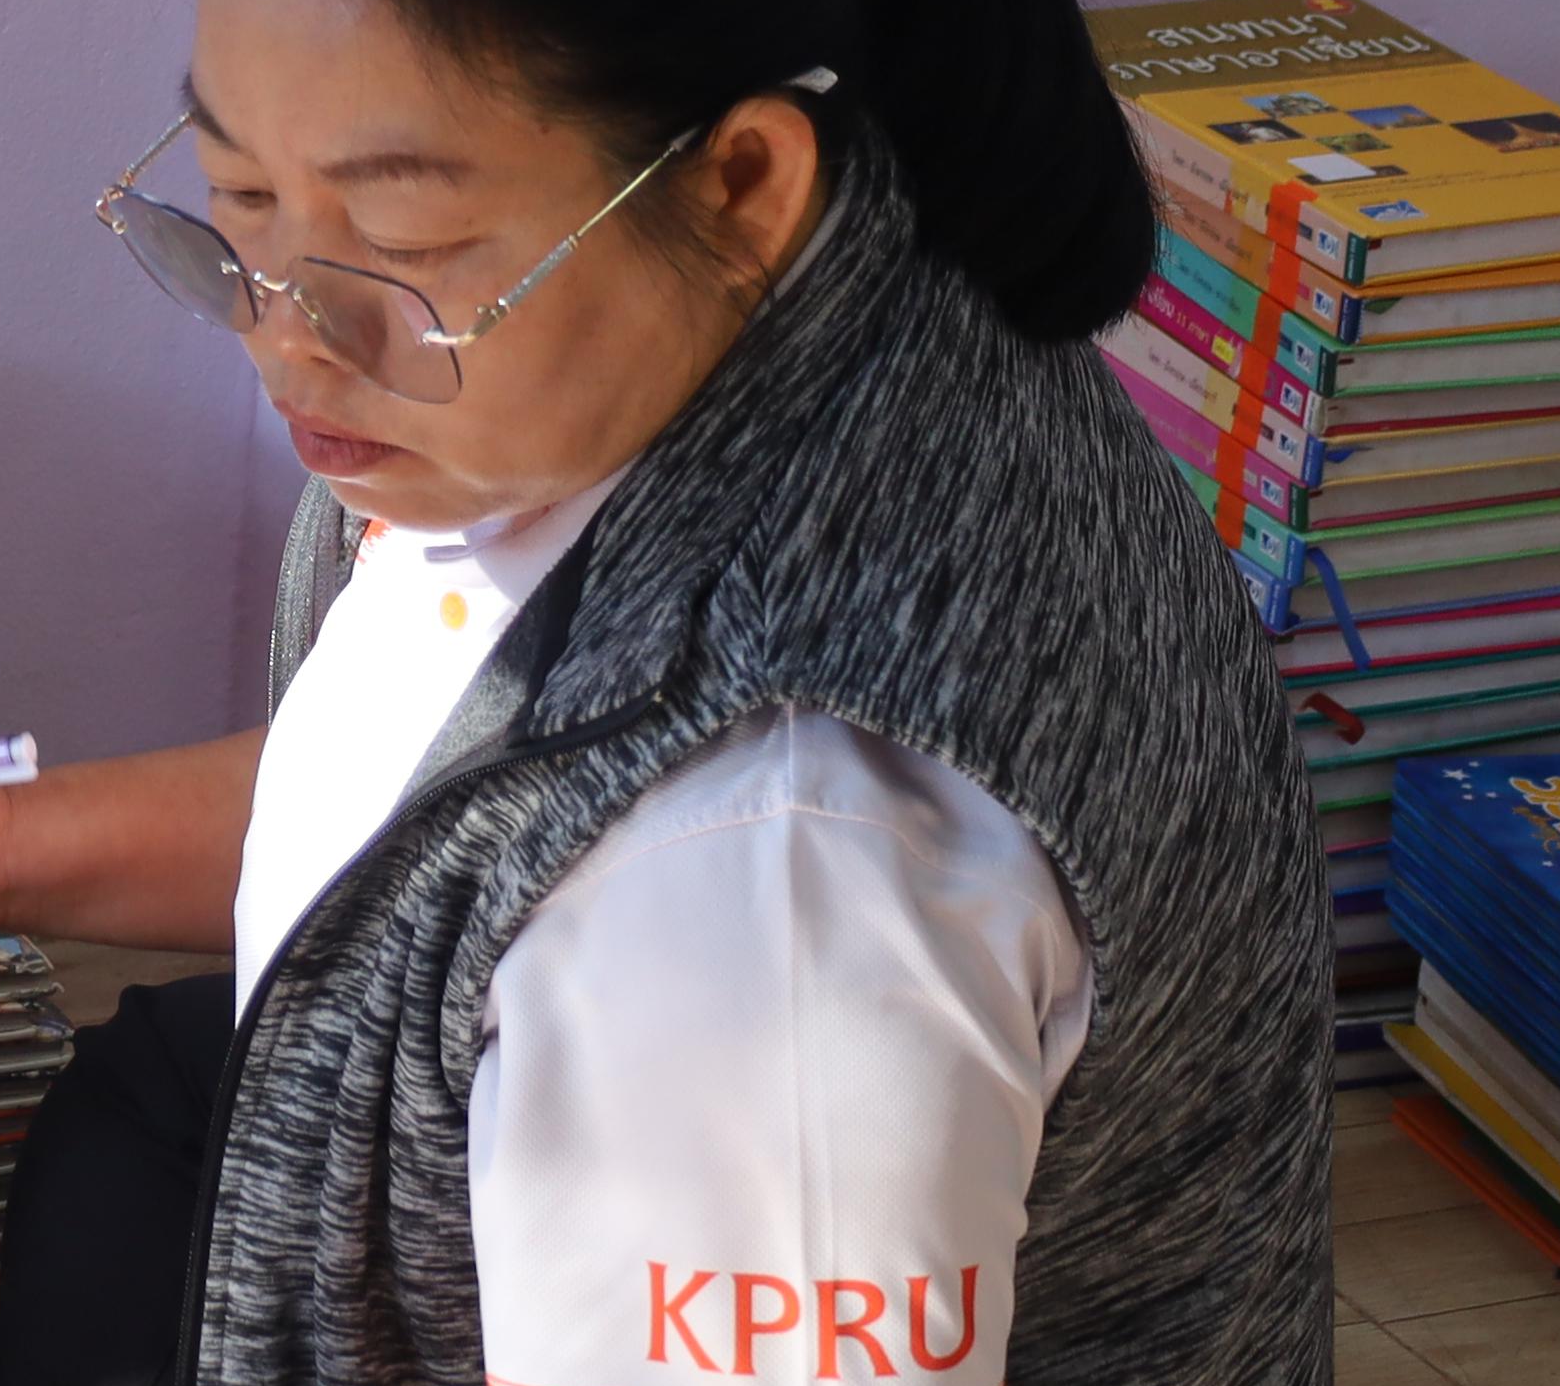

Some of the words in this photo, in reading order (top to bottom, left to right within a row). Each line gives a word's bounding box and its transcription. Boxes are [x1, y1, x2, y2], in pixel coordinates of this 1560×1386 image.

[1147, 13, 1347, 47] สนทนา
[1110, 34, 1430, 80] ภาษาอาเซียน
[646, 1260, 979, 1380] KPRU
